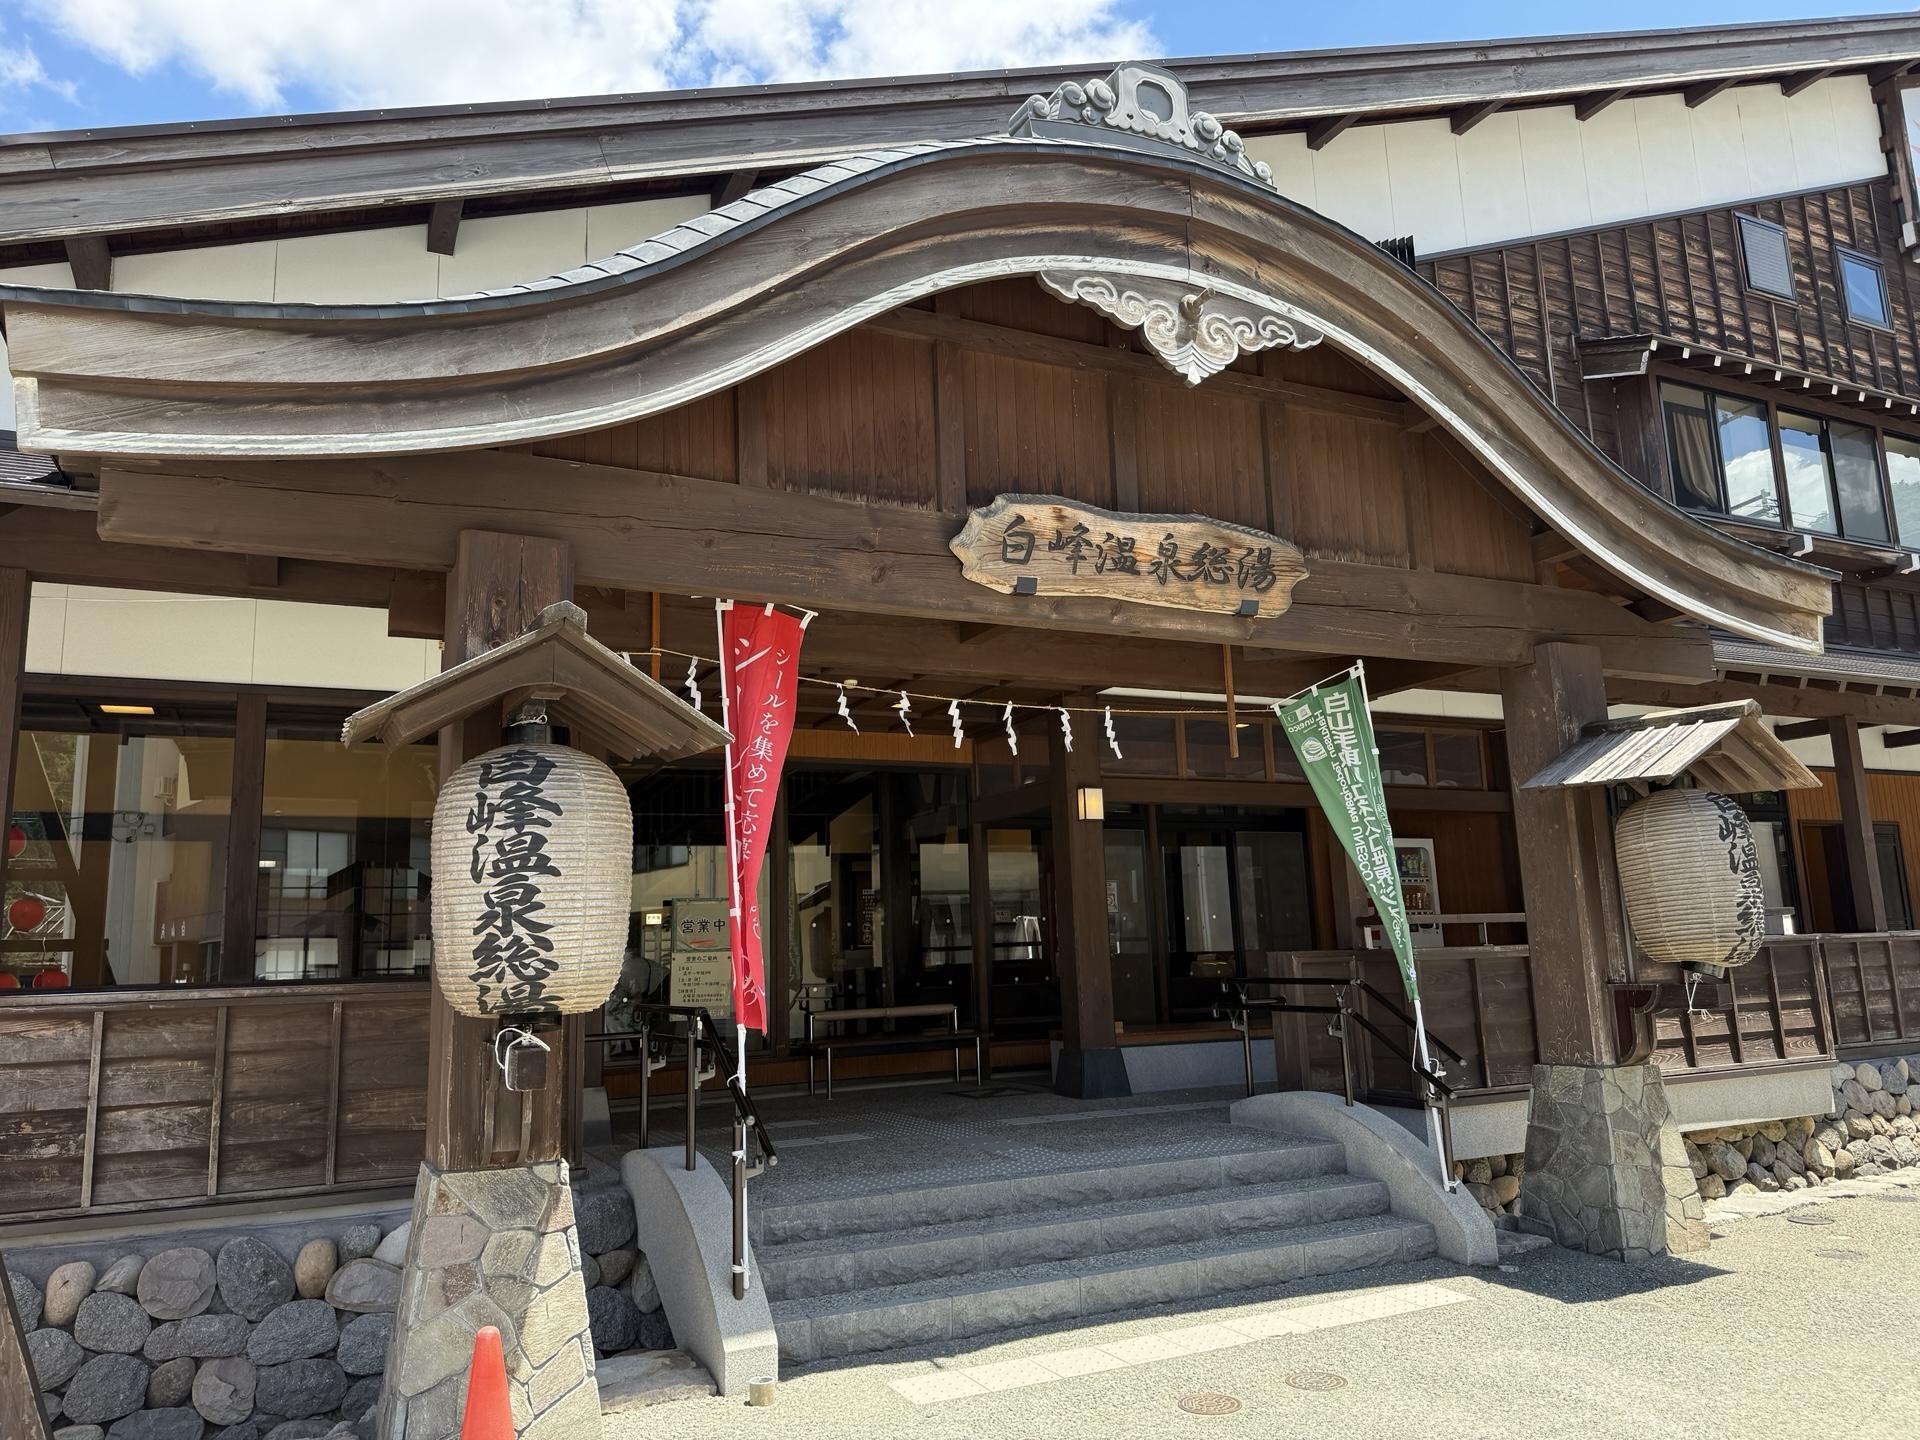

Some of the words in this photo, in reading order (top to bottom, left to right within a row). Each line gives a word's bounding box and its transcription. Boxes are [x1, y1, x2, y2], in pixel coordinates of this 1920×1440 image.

[1001, 514, 1277, 594] 白峰温泉総湯
[466, 750, 565, 1014] 白峰温泉総湯
[680, 918, 726, 934] 営業中
